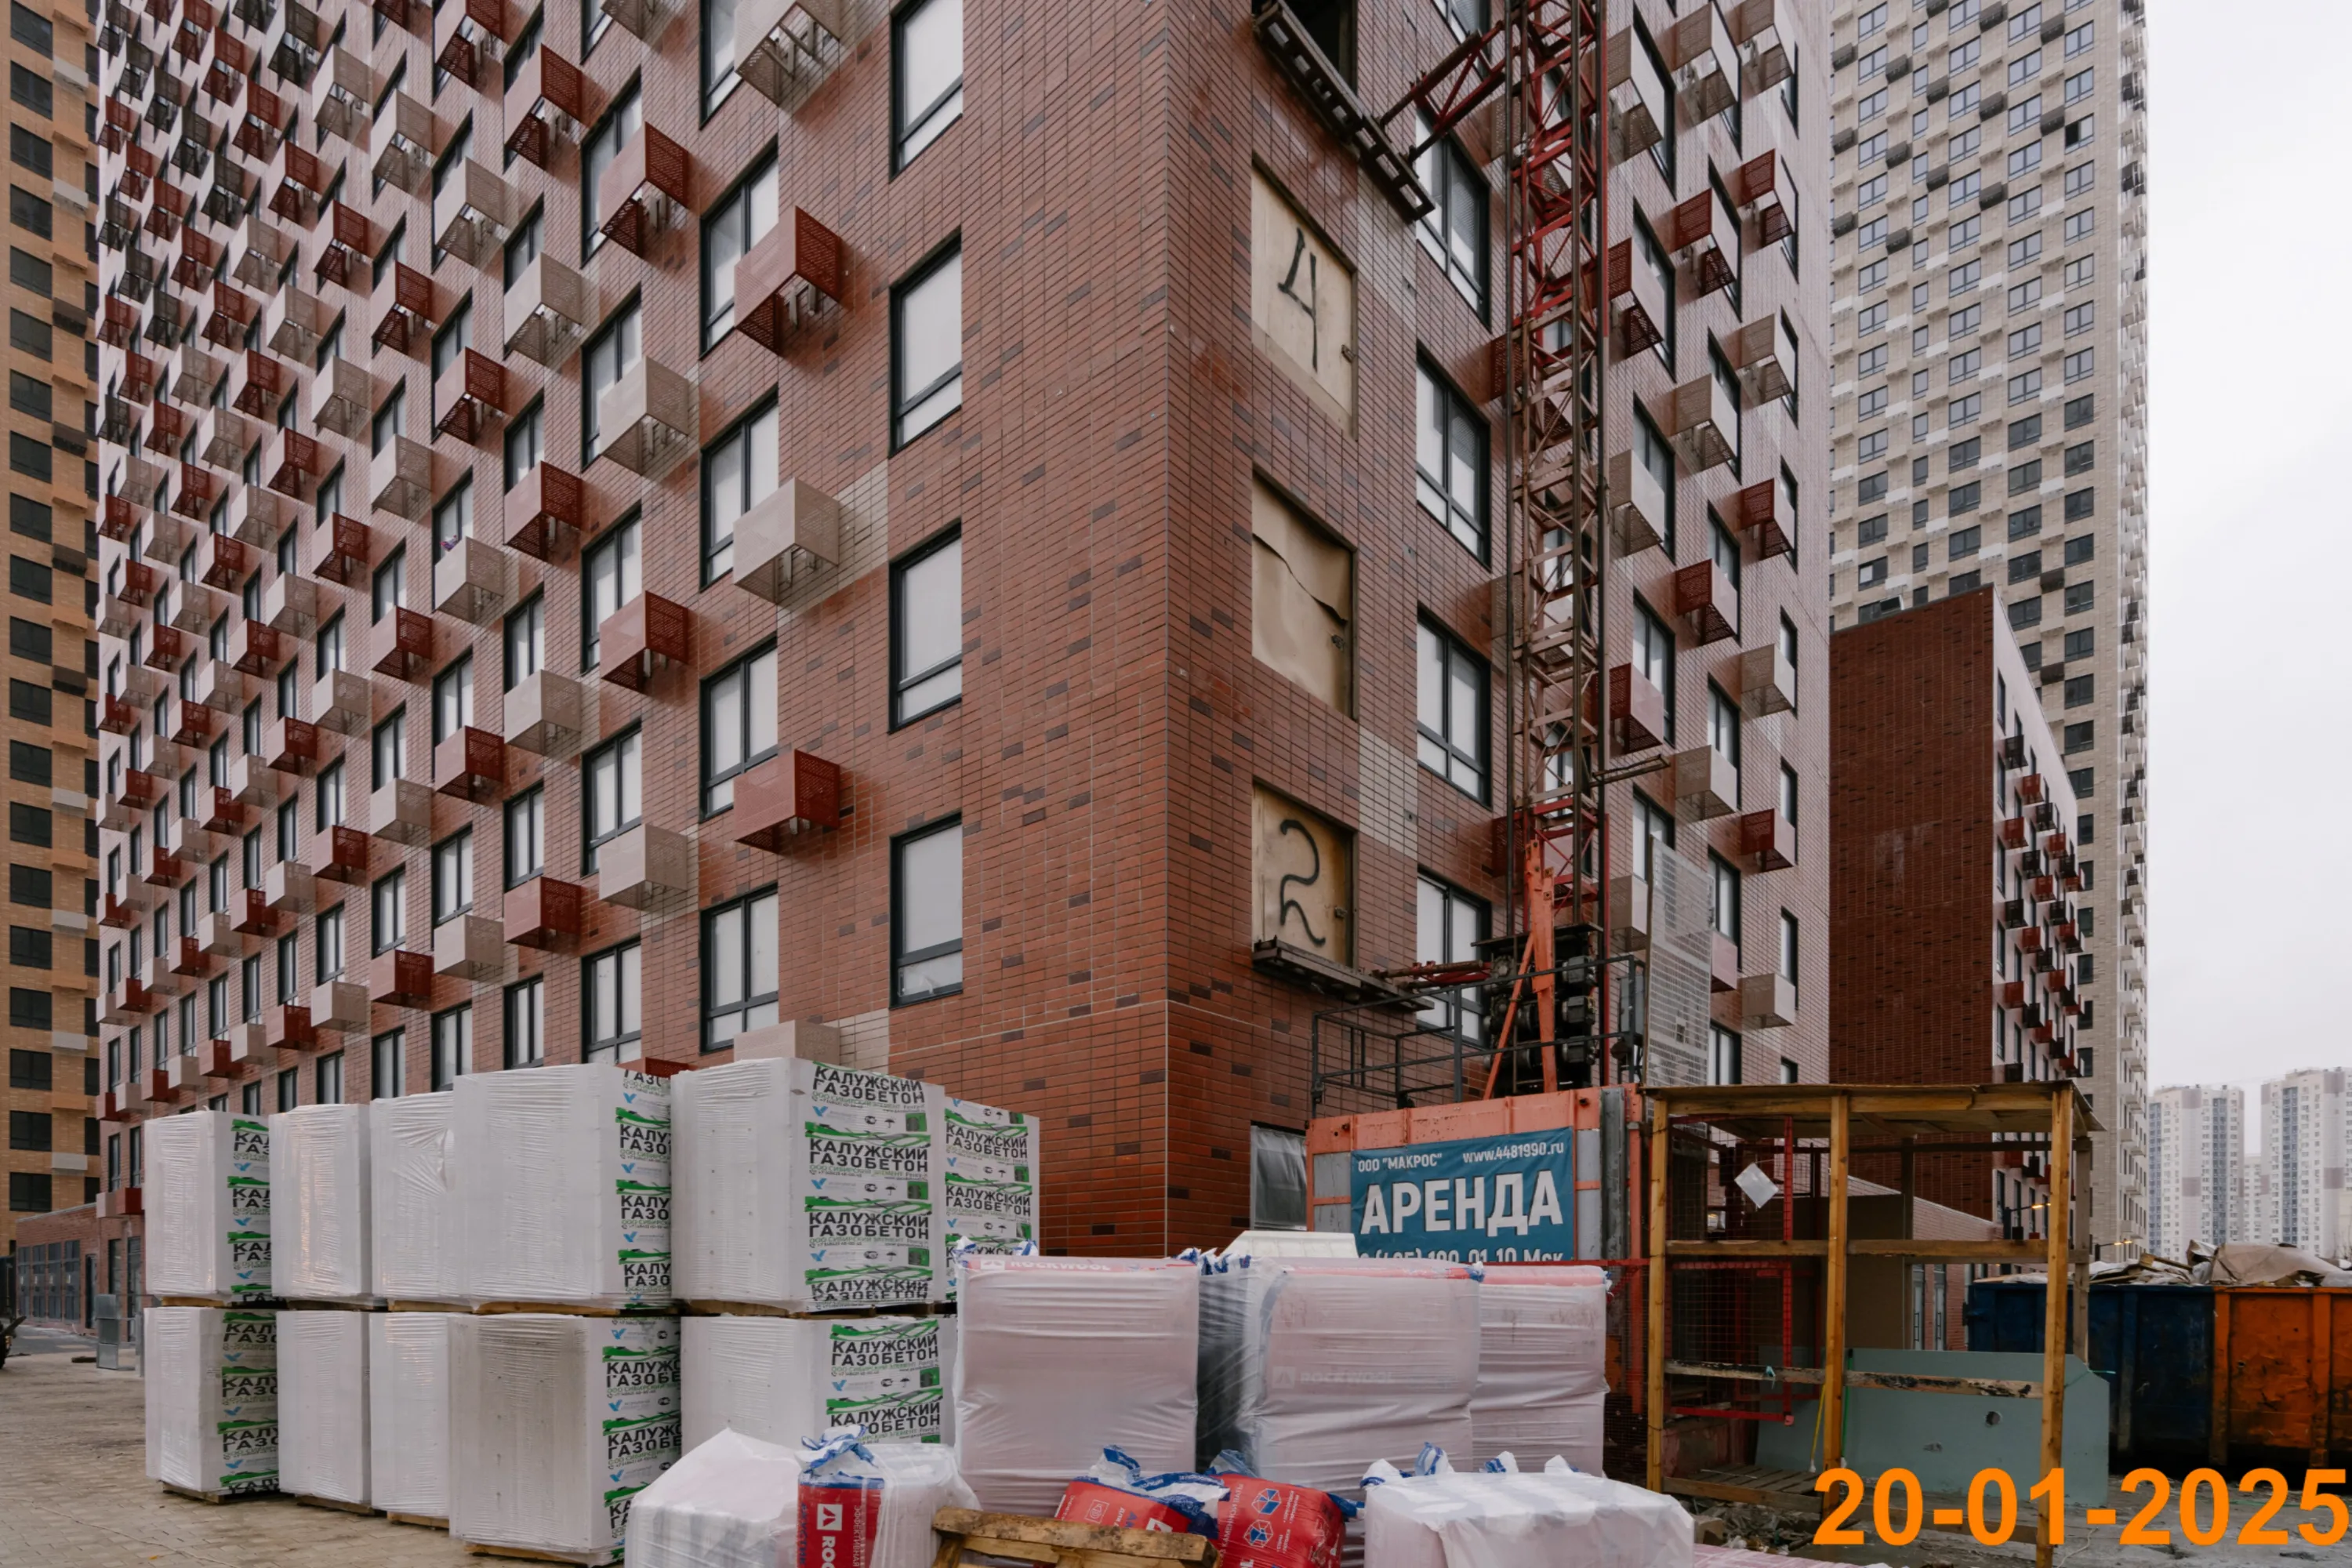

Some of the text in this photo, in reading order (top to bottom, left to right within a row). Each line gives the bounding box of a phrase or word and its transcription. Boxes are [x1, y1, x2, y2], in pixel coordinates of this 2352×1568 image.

[1277, 226, 1318, 373] 4
[1279, 818, 1326, 947] 2
[815, 1065, 923, 1092] КАЛУЖСКИЙ
[812, 1077, 925, 1105] ГАЗОБЕТОН
[619, 1123, 671, 1144] КАЛУ
[946, 1122, 1027, 1148] КАЛУЖСКИЙ
[810, 1138, 927, 1160] КАЛУЖСКИЙ
[946, 1133, 1028, 1159] ГАЗОБЕТОН
[1463, 1142, 1564, 1163] www.4481990.ru
[810, 1151, 928, 1172] ГАЗОБЕТОН
[1358, 1153, 1442, 1173] ООО "МАКРОС"
[621, 1195, 670, 1208] КАЛУ
[946, 1185, 1031, 1206] КАЛУЖСКИЙ
[1359, 1169, 1563, 1237] АРЕНДА
[621, 1207, 670, 1220] ГАЗО
[946, 1196, 1031, 1217] ГАЗОБЕТОН
[809, 1211, 928, 1229] КАЛУЖСКИЙ
[809, 1224, 929, 1240] ГАЗОБЕТОН
[624, 1263, 671, 1276] КАЛУ
[1011, 1261, 1111, 1271] ROCKWOOL
[624, 1274, 671, 1287] ГАЗО
[811, 1279, 928, 1296] КАЛУЖСКИЙ
[833, 1334, 938, 1354] КАЛУЖСКИЙ
[831, 1345, 938, 1367] ГАЗОБЕТОН
[1301, 1371, 1392, 1384] ROCKWOOL
[831, 1402, 940, 1427] КАЛУЖСКИЙ
[852, 1504, 861, 1566] ЭФФЕКТИВНАЯ
